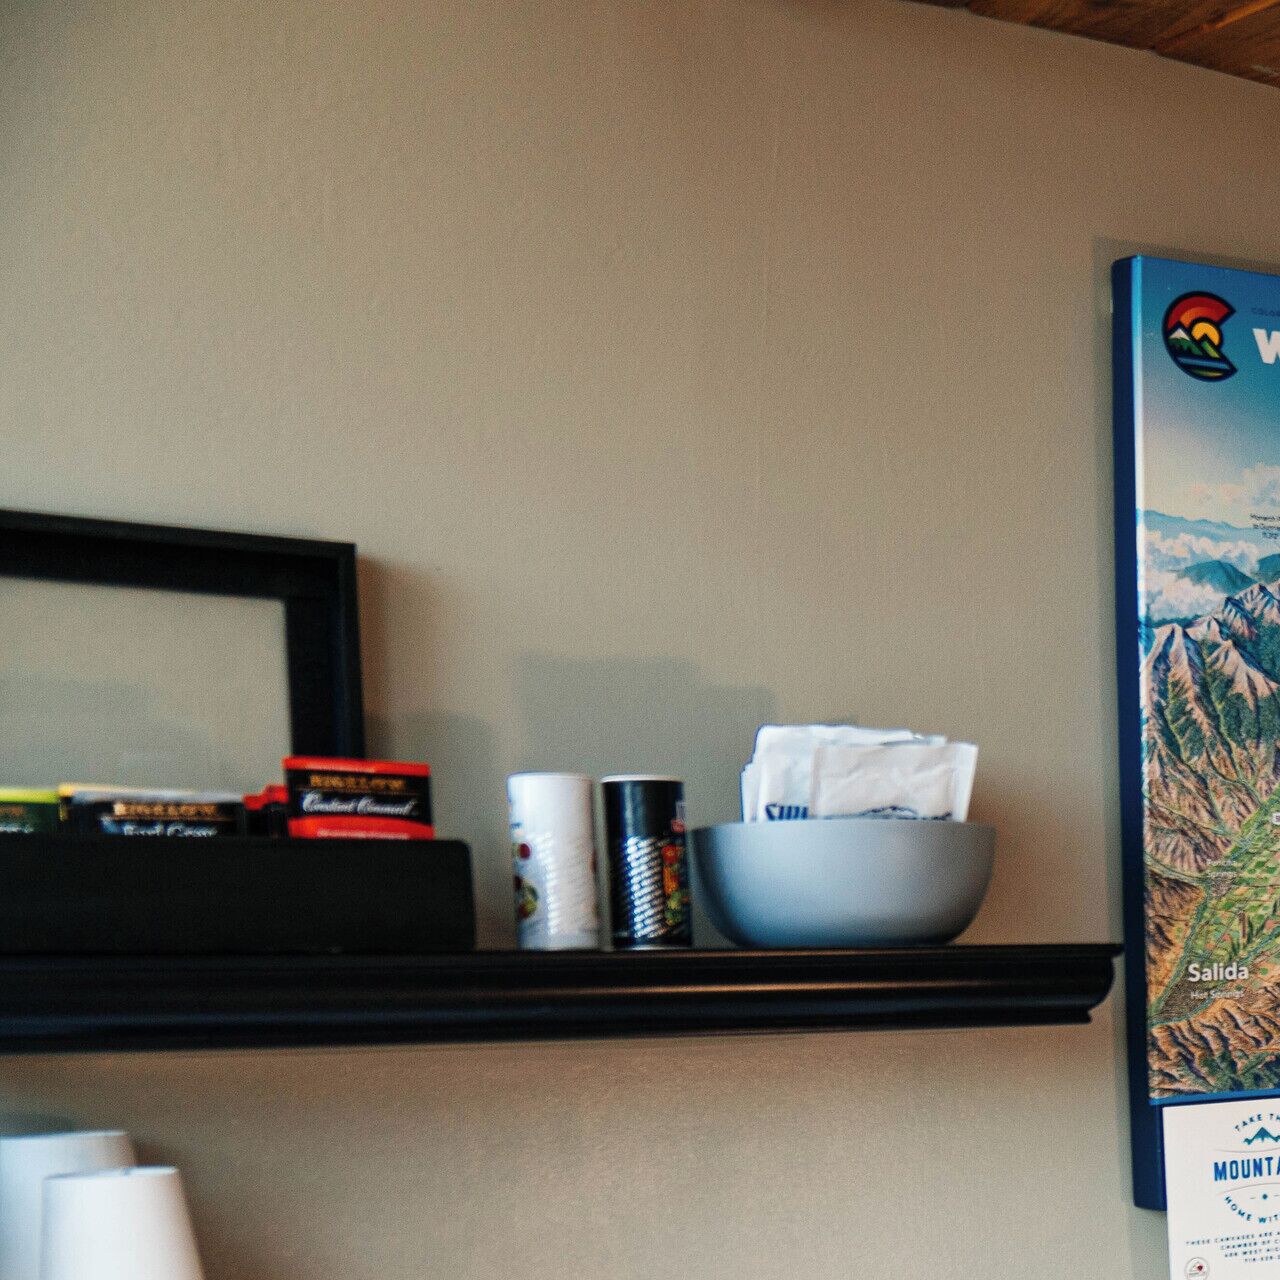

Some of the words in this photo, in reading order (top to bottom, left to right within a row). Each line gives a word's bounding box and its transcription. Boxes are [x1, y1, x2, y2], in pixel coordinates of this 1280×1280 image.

[1187, 961, 1249, 982] Salida
[1234, 1113, 1263, 1132] TAKE
[1224, 1195, 1253, 1222] HOME
